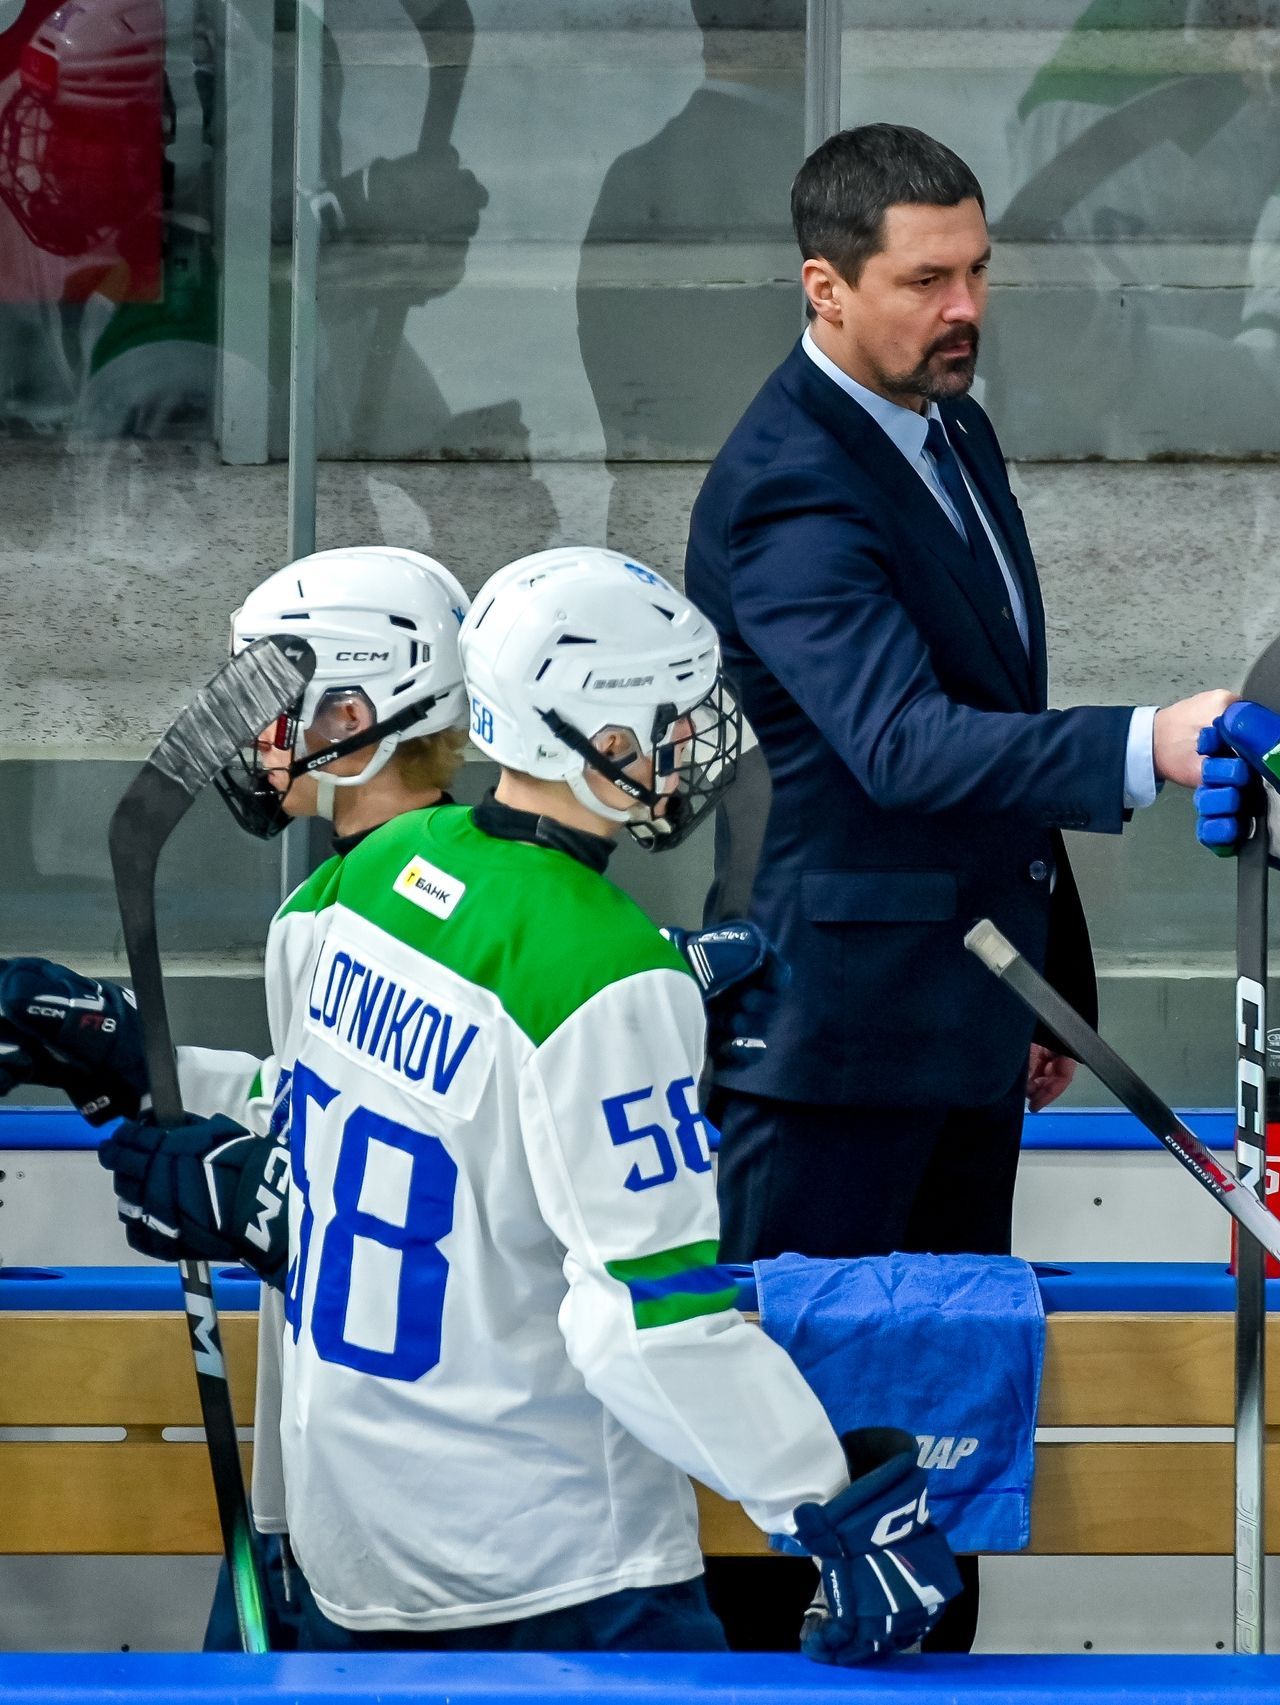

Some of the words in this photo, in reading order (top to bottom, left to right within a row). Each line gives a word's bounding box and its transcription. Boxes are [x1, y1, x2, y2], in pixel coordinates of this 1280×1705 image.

[336, 651, 389, 662] CCM
[593, 676, 655, 690] BAUER
[472, 698, 494, 744] 58
[307, 752, 338, 769] CCM
[415, 877, 451, 904] БАНК
[27, 1005, 66, 1019] CCM
[1164, 1135, 1224, 1194] COMPOSITE
[245, 1146, 291, 1252] CM
